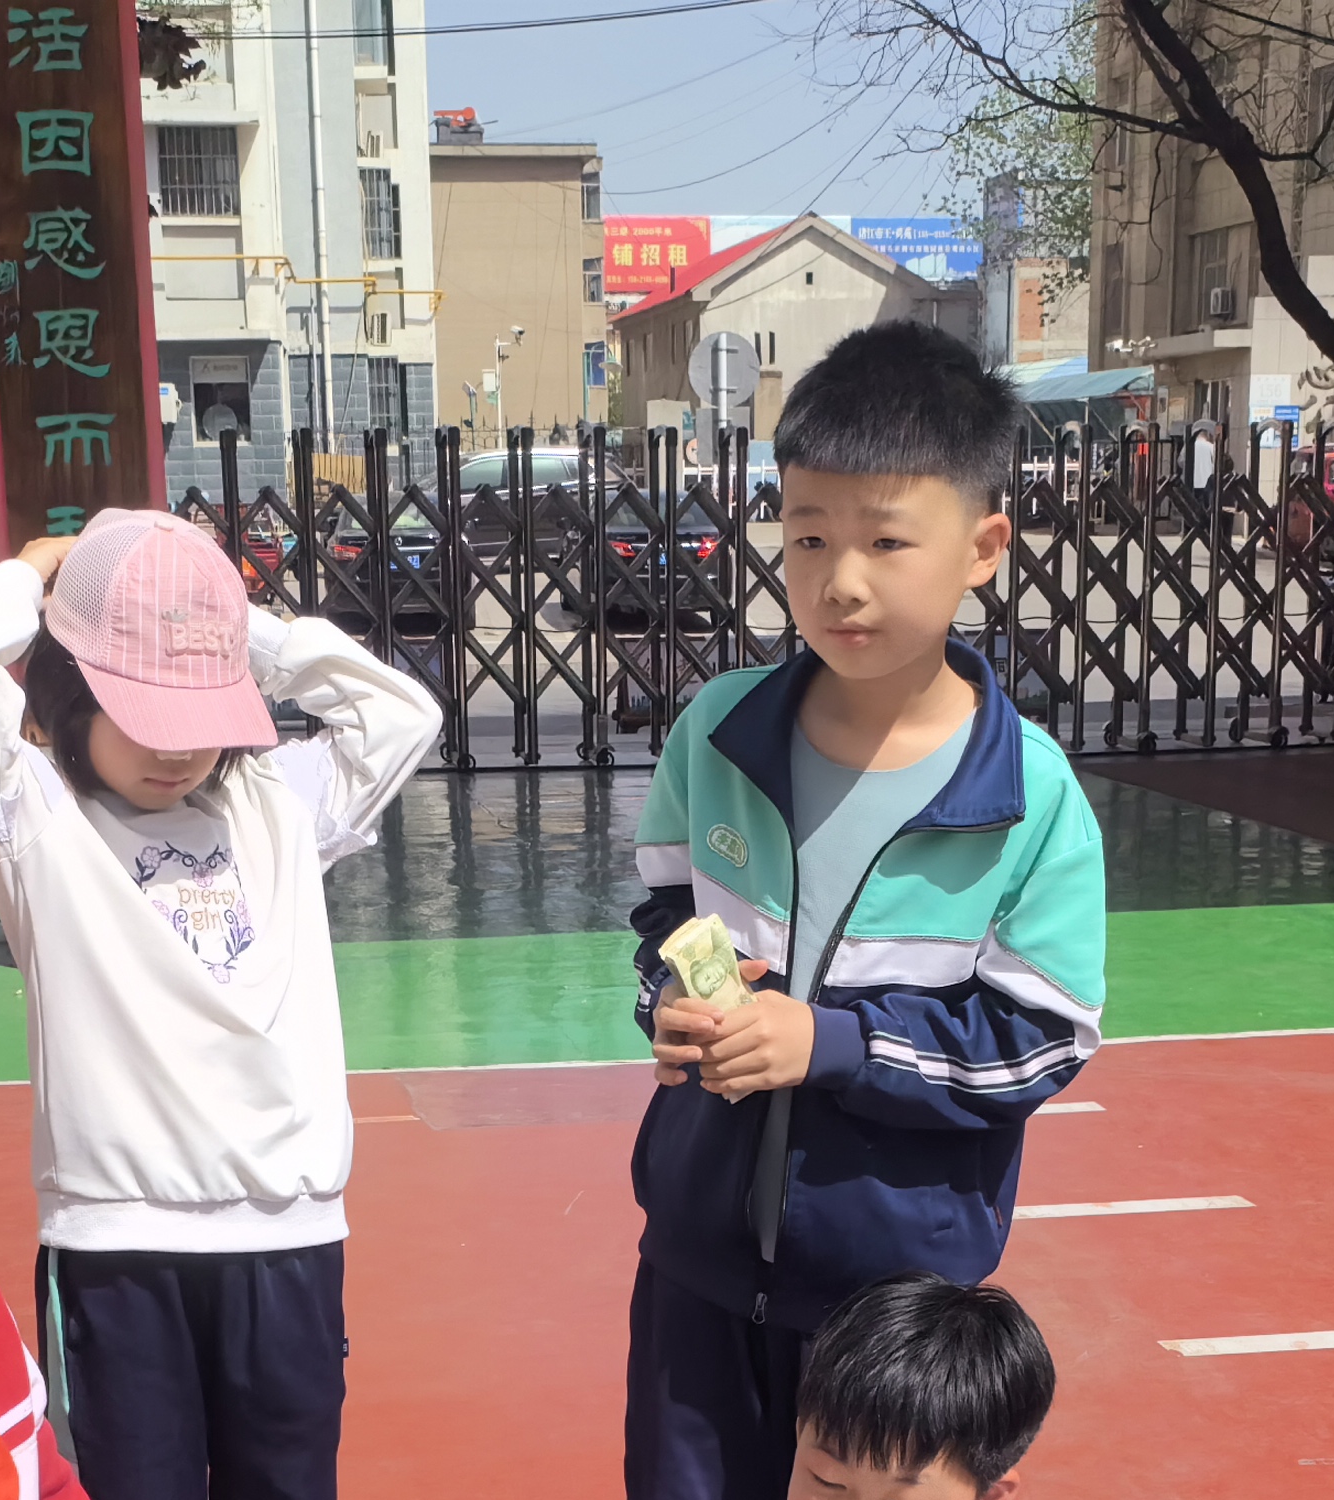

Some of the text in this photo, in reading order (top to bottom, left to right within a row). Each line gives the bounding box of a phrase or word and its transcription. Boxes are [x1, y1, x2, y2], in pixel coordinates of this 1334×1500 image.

[612, 243, 688, 267] 铺招租
[169, 623, 234, 658] BEST
[178, 886, 237, 908] pretty
[190, 907, 223, 933] girl
